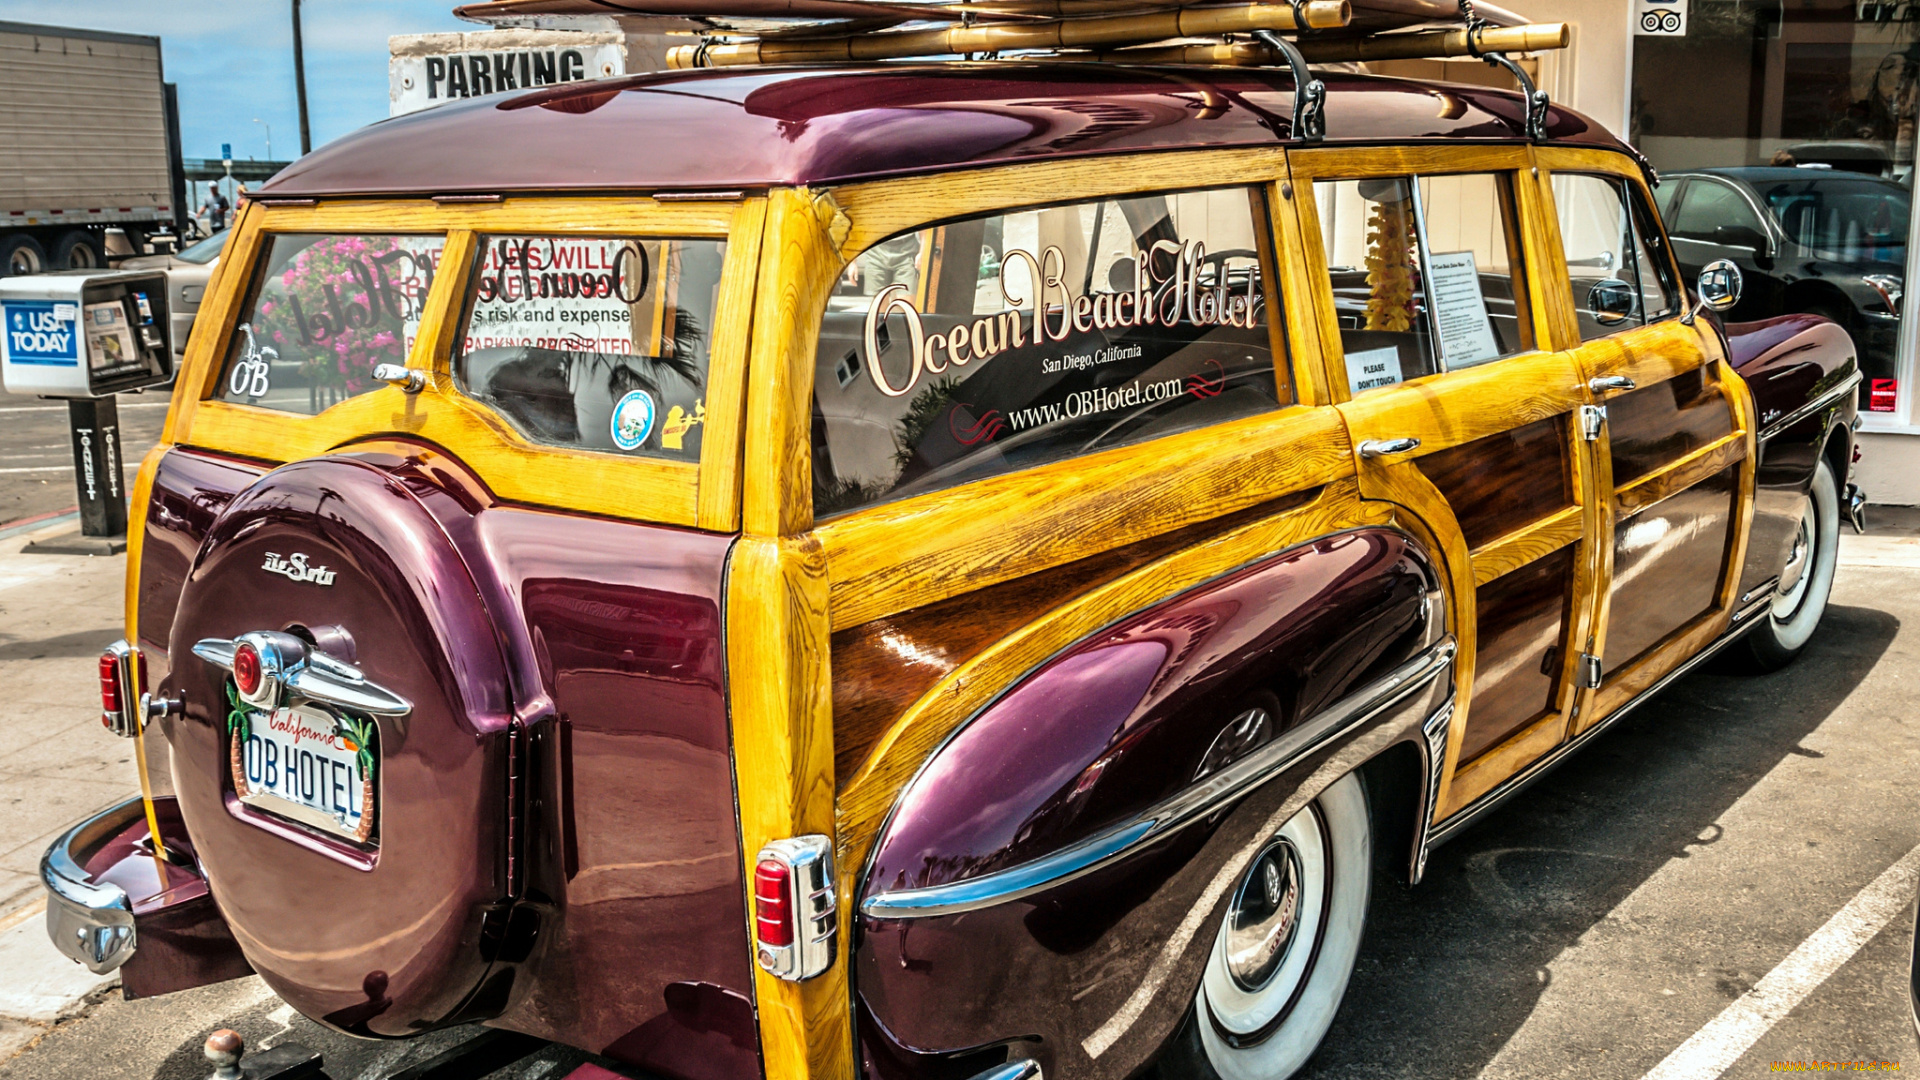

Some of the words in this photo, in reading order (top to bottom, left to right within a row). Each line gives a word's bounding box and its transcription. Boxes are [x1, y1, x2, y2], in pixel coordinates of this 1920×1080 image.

[426, 50, 584, 99] PARKING
[552, 246, 615, 270] WILL
[29, 312, 68, 332] USA
[488, 308, 518, 322] risk
[524, 307, 554, 322] and
[560, 310, 630, 326] expense
[865, 284, 1026, 397] Ocean
[999, 245, 1156, 345] Beach
[1149, 239, 1258, 329] Hotel
[11, 332, 71, 352] TODAY
[1042, 358, 1061, 374] San
[1063, 354, 1094, 370] Diego,
[1094, 344, 1142, 364] California
[1363, 363, 1385, 374] PLEASE
[230, 361, 269, 397] OB
[1357, 379, 1375, 389] DON'T
[1376, 376, 1396, 386] TOUCH
[1008, 378, 1183, 431] www.OBHotel.com
[269, 711, 345, 751] California
[248, 734, 279, 788] OB
[284, 745, 361, 818] HOTEL
